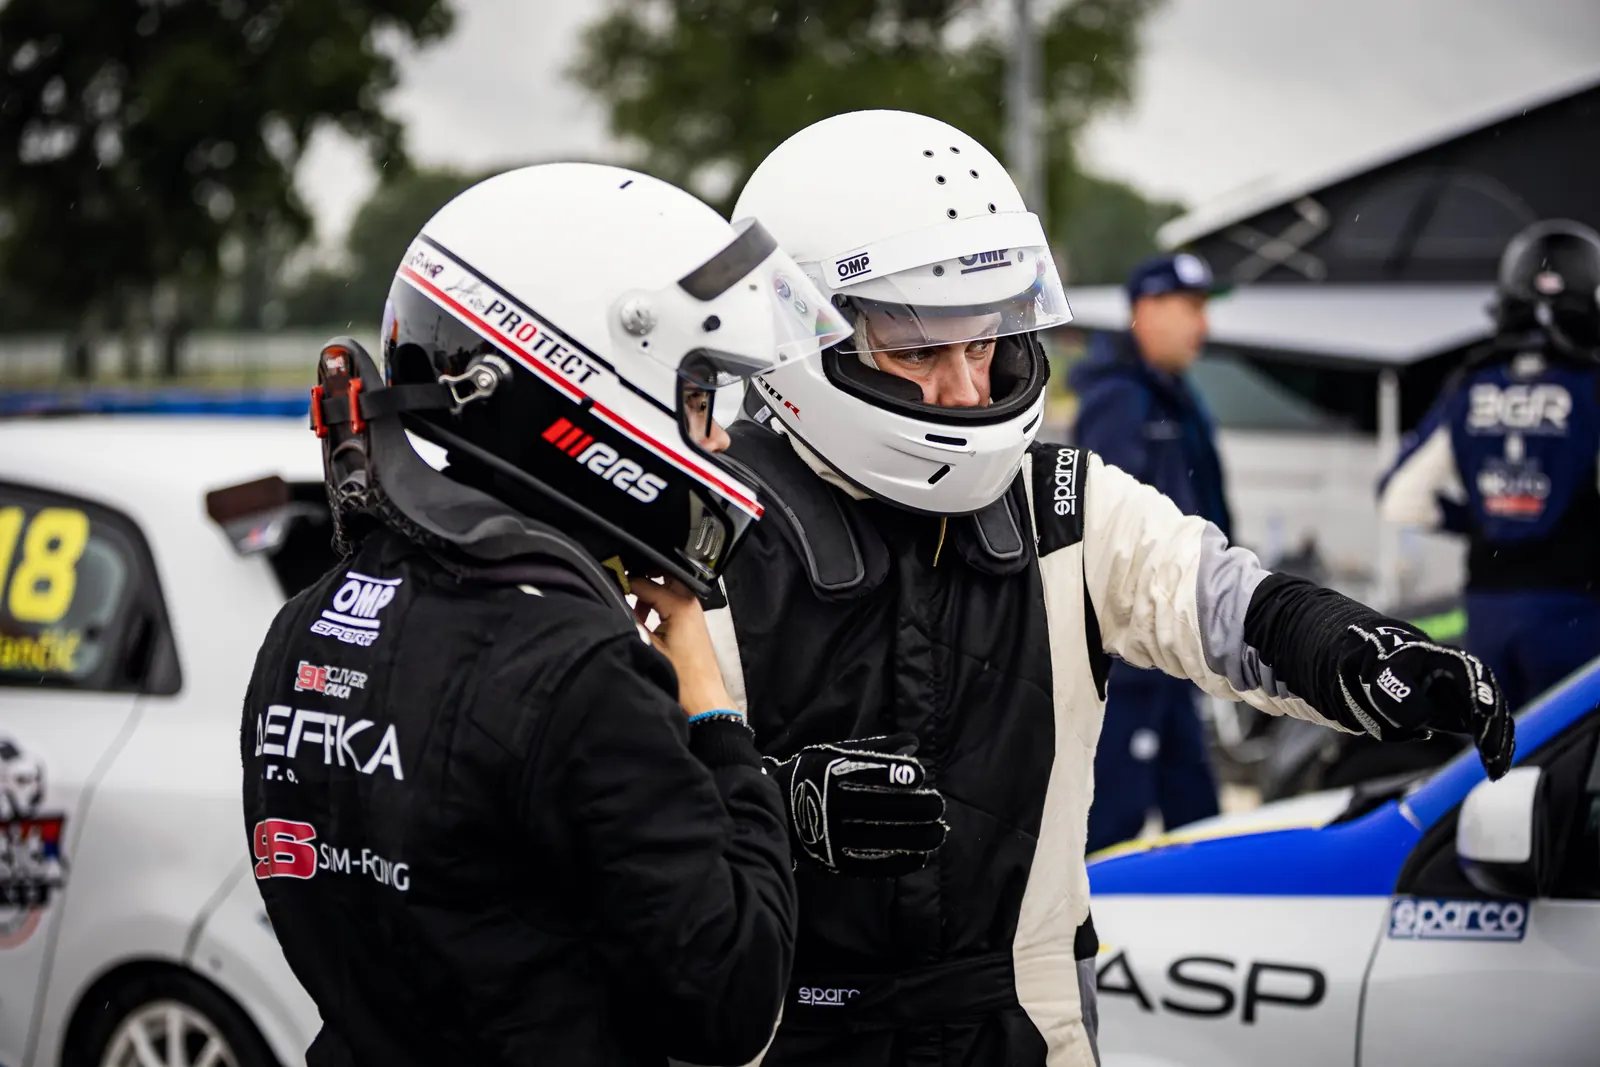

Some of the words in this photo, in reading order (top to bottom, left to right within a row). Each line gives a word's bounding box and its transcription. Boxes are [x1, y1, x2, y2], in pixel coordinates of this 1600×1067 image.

[836, 254, 871, 280] OMP
[484, 300, 600, 384] PROTECT
[576, 441, 668, 503] RRS
[332, 577, 397, 620] OMP
